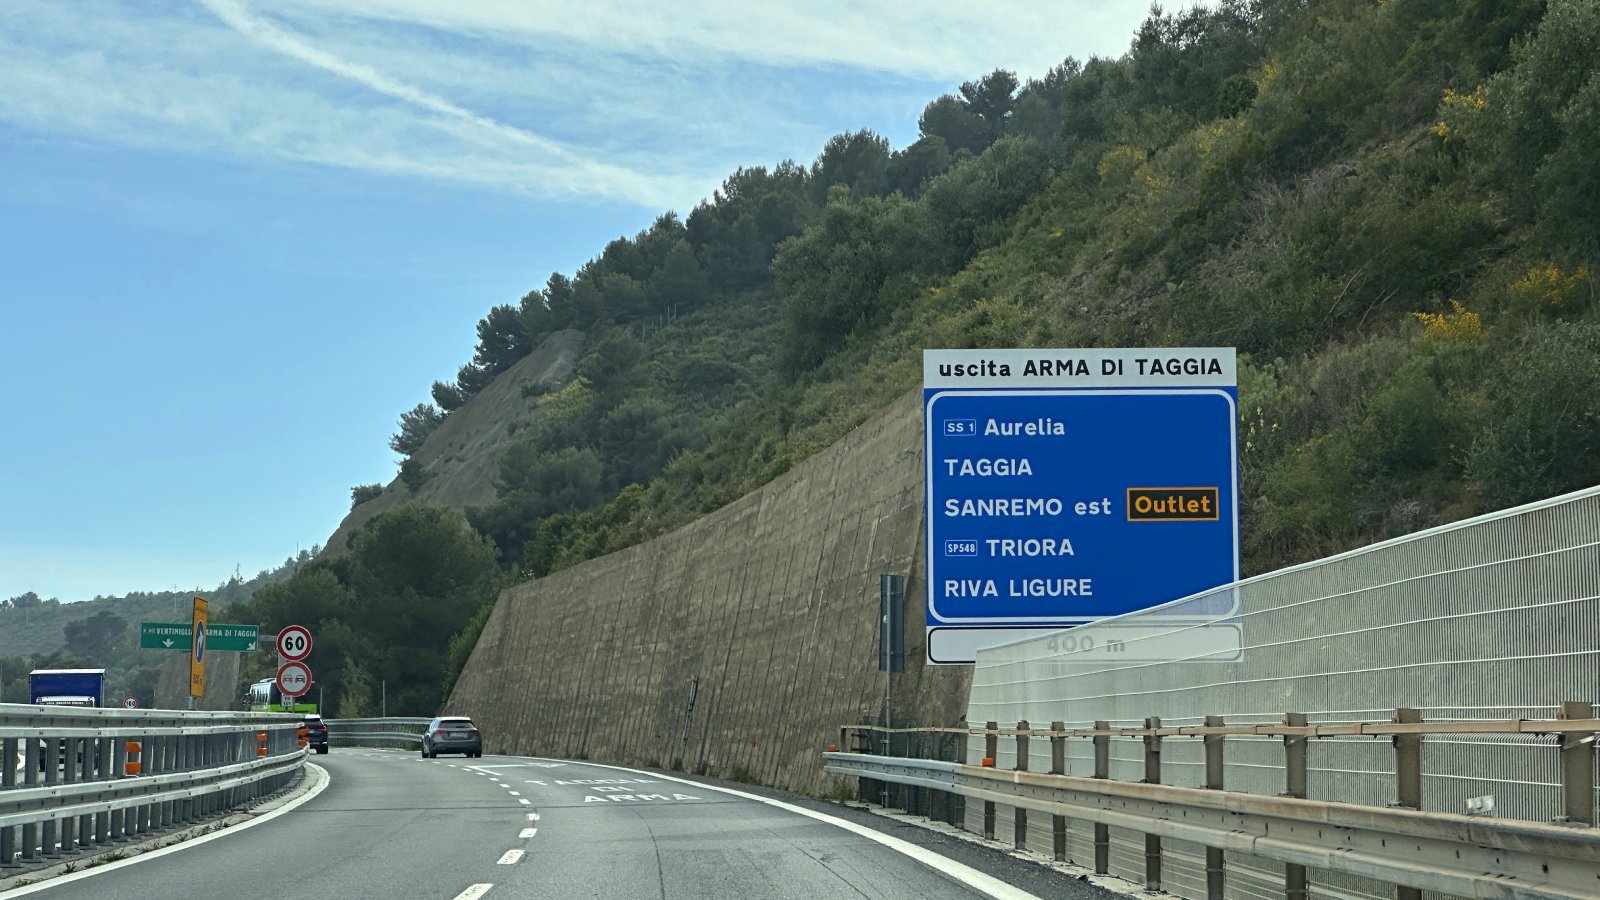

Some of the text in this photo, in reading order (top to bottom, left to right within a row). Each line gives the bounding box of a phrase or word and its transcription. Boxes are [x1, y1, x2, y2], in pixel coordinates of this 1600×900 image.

[939, 357, 1223, 377] uscita ARMA DI TAGGIA
[947, 422, 964, 433] SS
[984, 417, 1065, 436] Aurelia
[943, 458, 1033, 477] TAGGIA
[944, 497, 1112, 517] SANREMO est
[1134, 495, 1211, 514] Outlet
[947, 538, 1075, 557] SP548 TRIORA
[945, 578, 1093, 598] RIVA LIGURE
[156, 627, 193, 636] VENTIMIGLI
[234, 630, 257, 638] TAGGIA
[285, 636, 305, 651] 60
[1047, 635, 1126, 653] 400 m
[584, 793, 702, 803] ARMA
